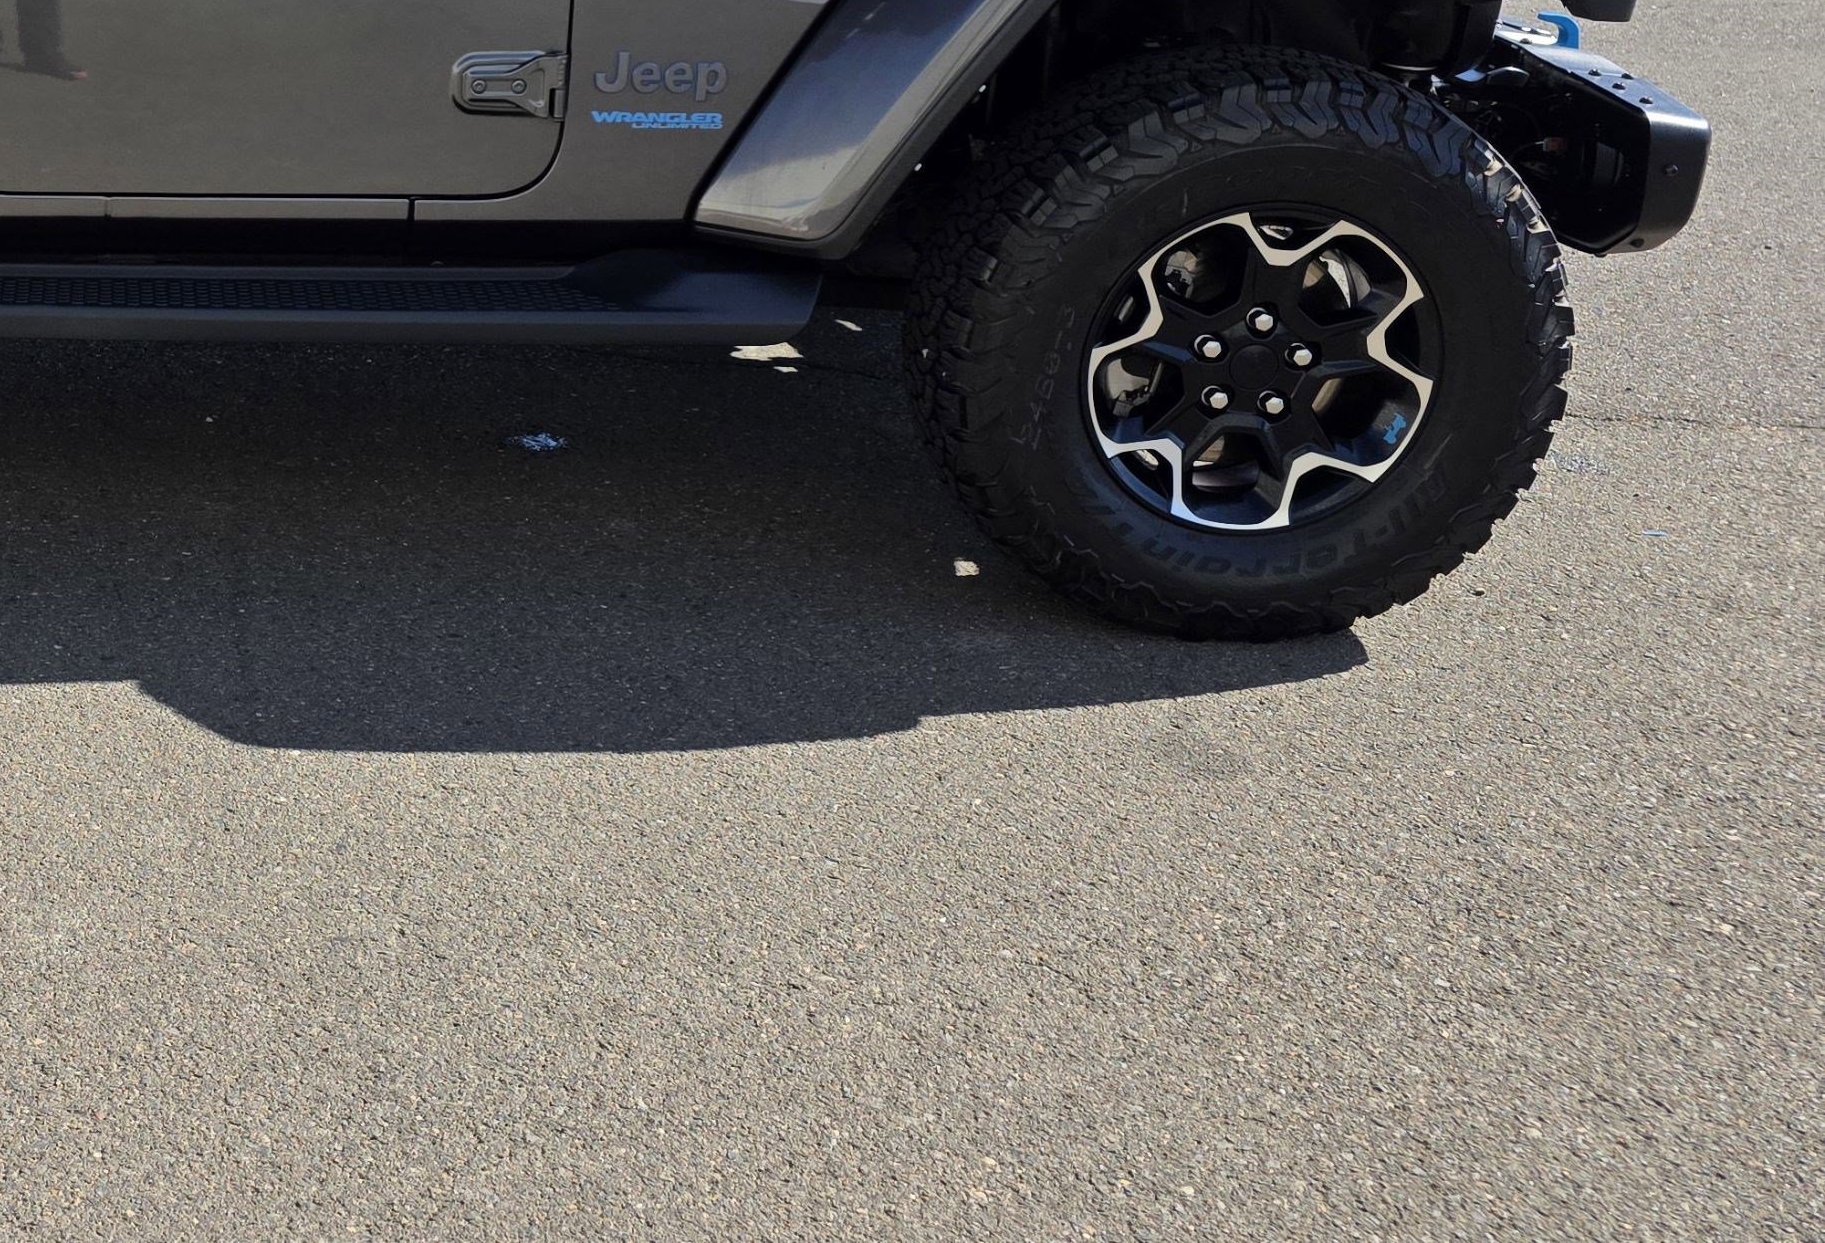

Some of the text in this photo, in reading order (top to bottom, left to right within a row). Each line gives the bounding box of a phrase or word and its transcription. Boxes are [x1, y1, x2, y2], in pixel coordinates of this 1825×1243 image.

[594, 50, 727, 102] Jeep
[591, 110, 724, 124] WRANGLER
[631, 122, 724, 130] UNLIMITED
